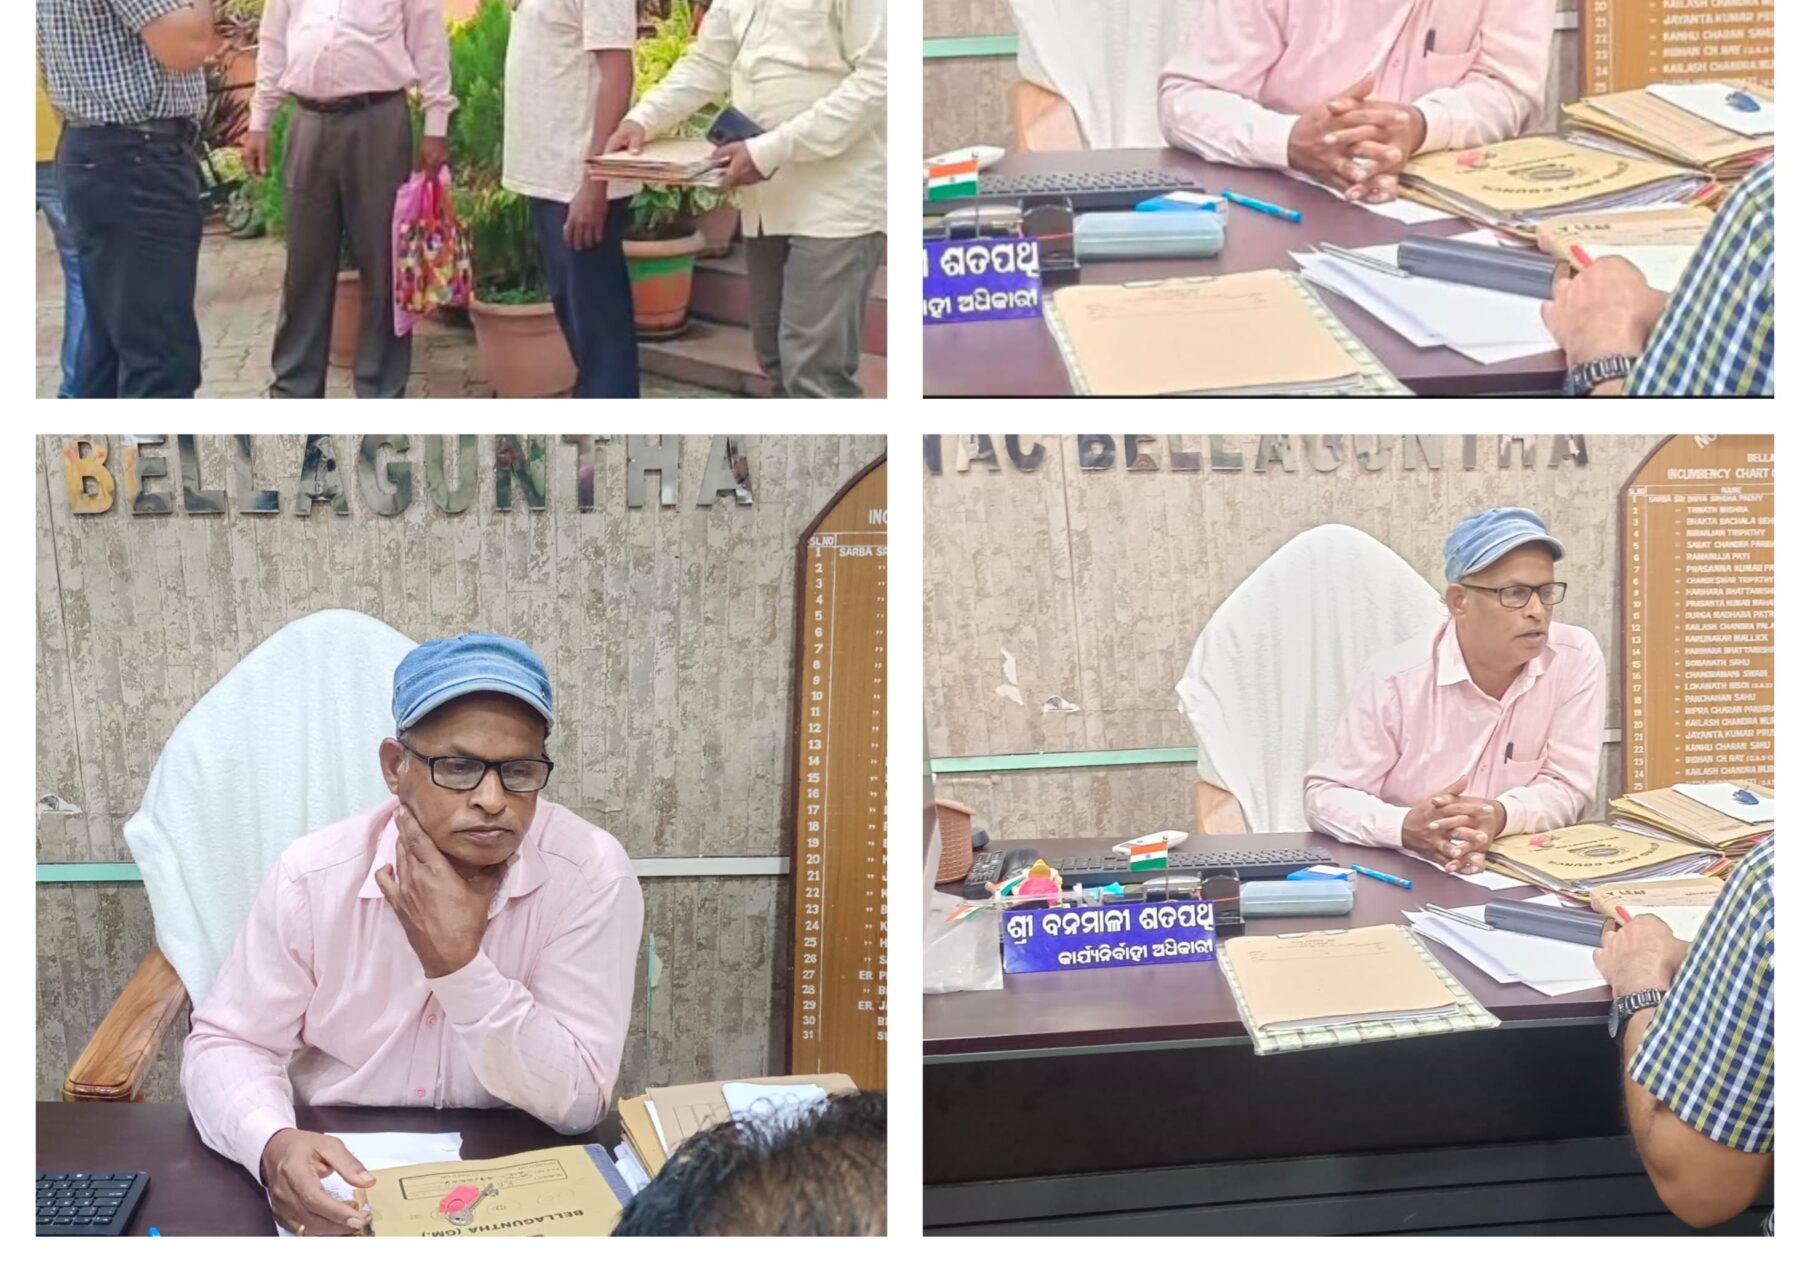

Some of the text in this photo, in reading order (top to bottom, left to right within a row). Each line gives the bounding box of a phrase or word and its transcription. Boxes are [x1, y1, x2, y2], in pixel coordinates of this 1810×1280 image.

[957, 287, 1038, 313] ଅଧିକାରୀ
[63, 434, 755, 515] BELLAGUNTHA
[1735, 468, 1769, 479] CHART
[1632, 518, 1639, 526] 3
[1633, 530, 1639, 538] 4
[1632, 542, 1639, 550] 5
[816, 547, 872, 557] 1 SARBA
[815, 564, 823, 572] 2
[816, 579, 823, 588] 3
[816, 595, 823, 604] 4
[815, 611, 823, 620] 5
[815, 628, 823, 637] 6
[1632, 624, 1640, 632] 12
[815, 644, 823, 653] 7
[813, 660, 820, 669] 8
[813, 676, 820, 685] 9
[1632, 684, 1642, 692] 17
[811, 691, 823, 700] 10
[811, 707, 820, 716] 11
[808, 724, 821, 733] 12
[1634, 733, 1643, 741] 21
[808, 740, 821, 749] 13
[1633, 746, 1644, 754] 22
[808, 756, 819, 765] 14
[1633, 758, 1643, 766] 23
[808, 774, 820, 783] 15
[1634, 770, 1644, 778] 24
[808, 789, 819, 798] 16
[808, 805, 820, 814] 17
[808, 822, 819, 831] 18
[808, 839, 819, 847] 19
[806, 855, 820, 864] 20
[808, 871, 820, 880] 21
[805, 888, 820, 897] 22
[805, 905, 819, 914] 23
[805, 921, 819, 930] 24
[1007, 914, 1033, 945] ଶ୍ରୀ
[1042, 908, 1131, 936] ବନମାଳୀ
[804, 938, 817, 947] 25
[1152, 937, 1214, 958] ଅଧିକାରୀ
[804, 954, 817, 963] 26
[803, 971, 815, 979] 27
[802, 986, 815, 994] 28
[803, 1001, 816, 1010] 29
[803, 1016, 815, 1025] 30
[802, 1031, 814, 1039] 31
[467, 1209, 584, 1234] BELLAGUNTHA
